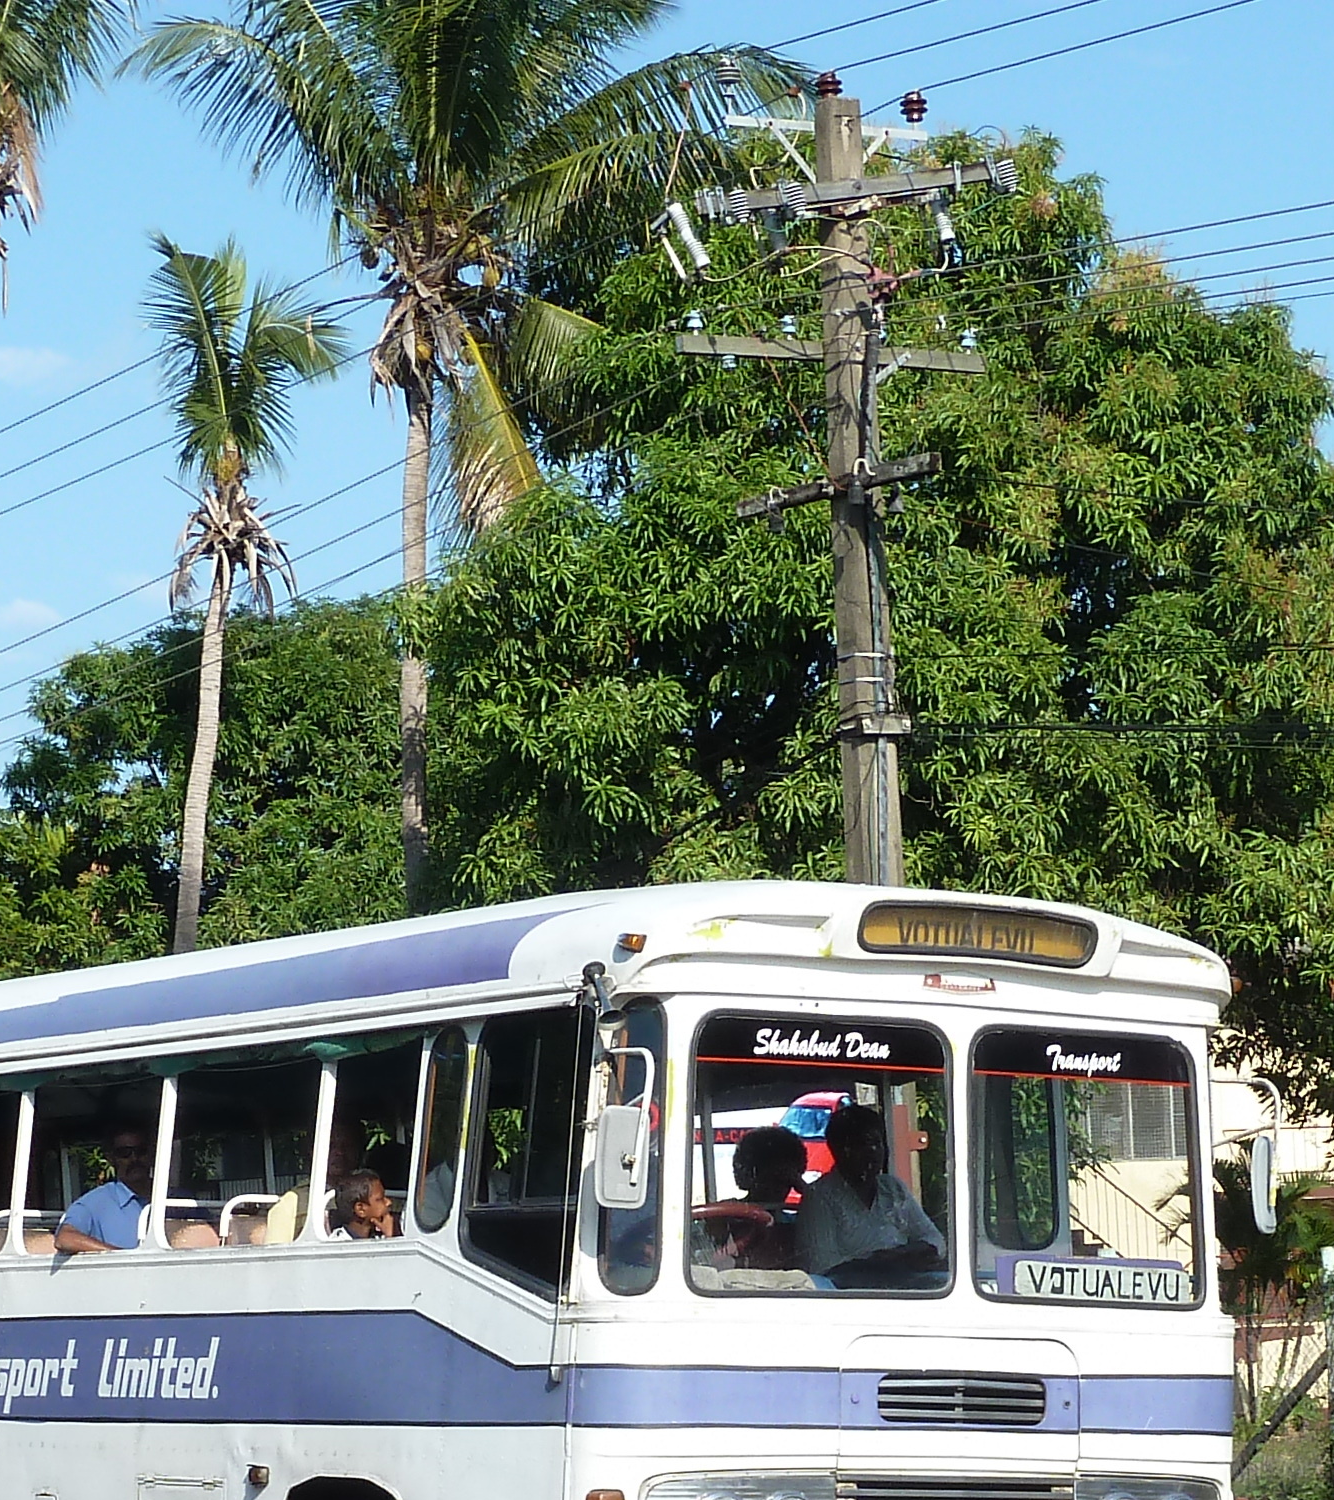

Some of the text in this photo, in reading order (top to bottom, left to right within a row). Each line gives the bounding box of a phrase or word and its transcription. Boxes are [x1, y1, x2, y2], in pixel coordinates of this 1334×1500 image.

[753, 1028, 890, 1060] Shahabud Dean
[1046, 1044, 1121, 1078] Transport
[1027, 1264, 1180, 1301] VOTUALEVU
[97, 1336, 220, 1399] Limited.
